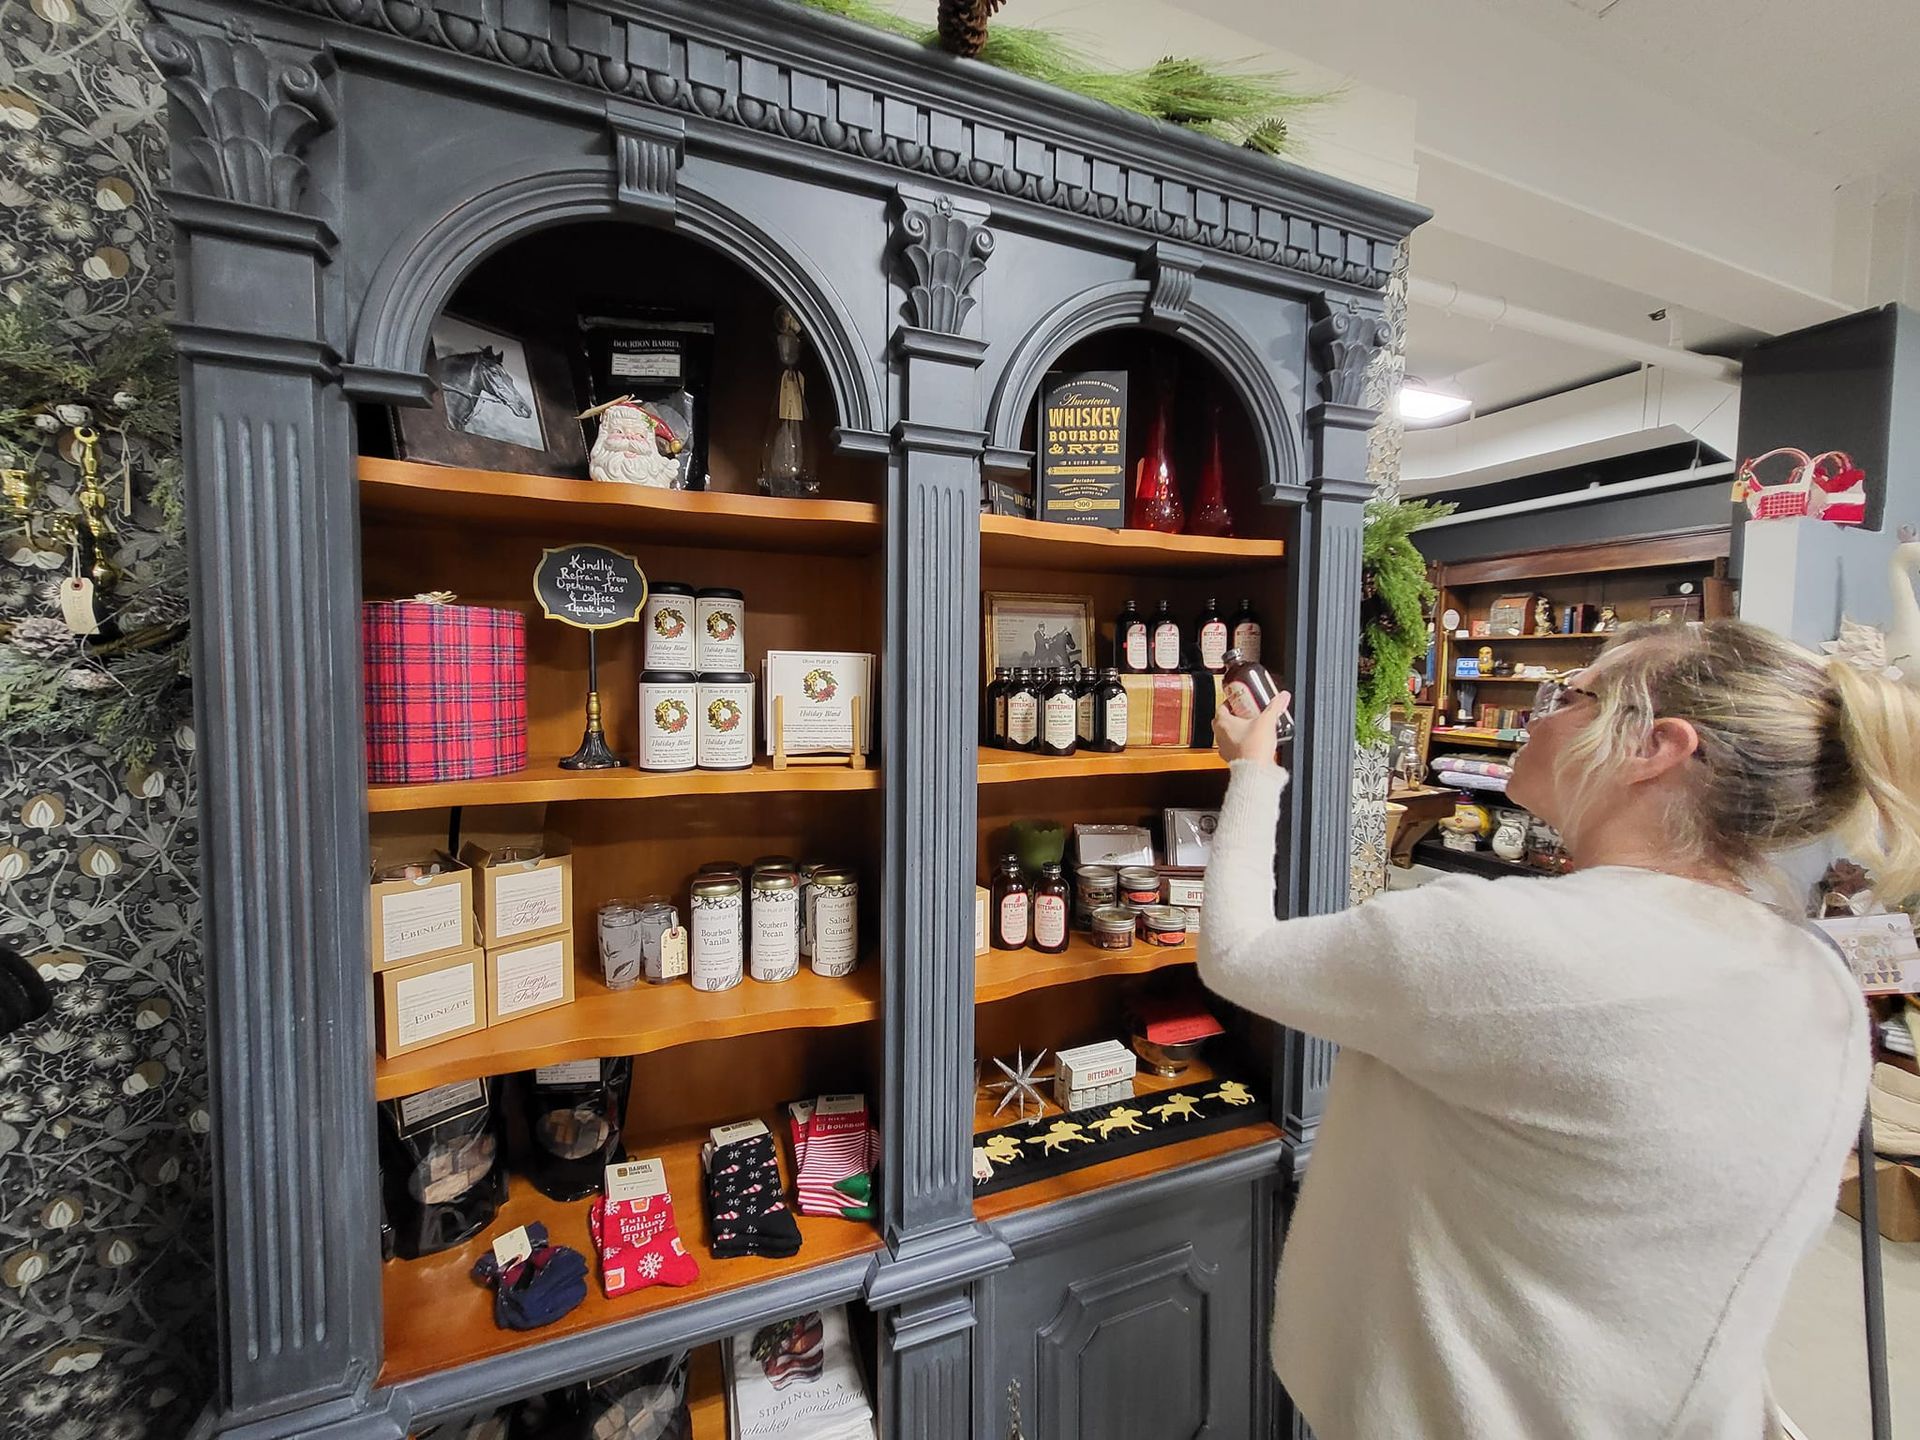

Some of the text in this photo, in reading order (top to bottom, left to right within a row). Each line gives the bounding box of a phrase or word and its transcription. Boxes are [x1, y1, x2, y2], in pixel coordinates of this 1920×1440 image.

[613, 339, 680, 348] BOURBON BARREL
[1059, 392, 1111, 406] American
[1048, 407, 1121, 428] WHISKEY
[1049, 430, 1120, 442] BOURBON
[1048, 443, 1120, 455] & RYE
[569, 554, 614, 572] Kindly
[560, 567, 628, 587] Refrain from
[556, 576, 624, 595] Opening Teas
[582, 592, 616, 605] Coffees
[565, 602, 597, 616] Thank
[651, 643, 673, 651] Holiday
[800, 710, 823, 718] Holiday
[652, 739, 676, 748] Holiday
[705, 738, 727, 746] Holiday
[516, 899, 547, 912] Sugar
[534, 905, 557, 915] Plum
[512, 912, 540, 926] Fairy
[757, 920, 788, 929] Southern
[829, 915, 850, 925] Salted
[701, 927, 732, 937] Bourbon
[762, 929, 784, 938] Pecan
[825, 925, 854, 936] Caramel
[703, 937, 731, 946] Vanilla
[517, 974, 547, 988] Sugar
[533, 980, 558, 991] Plum
[513, 987, 541, 1003] Fairy
[1087, 1066, 1124, 1081] BITTERMILK
[827, 1122, 865, 1130] BOURBON
[620, 1211, 667, 1226] Full of
[621, 1218, 666, 1234] Holiday
[623, 1225, 665, 1242] Spirit
[759, 1383, 844, 1418] SIPPING IN A
[740, 1388, 865, 1436] whiskey wonderland
